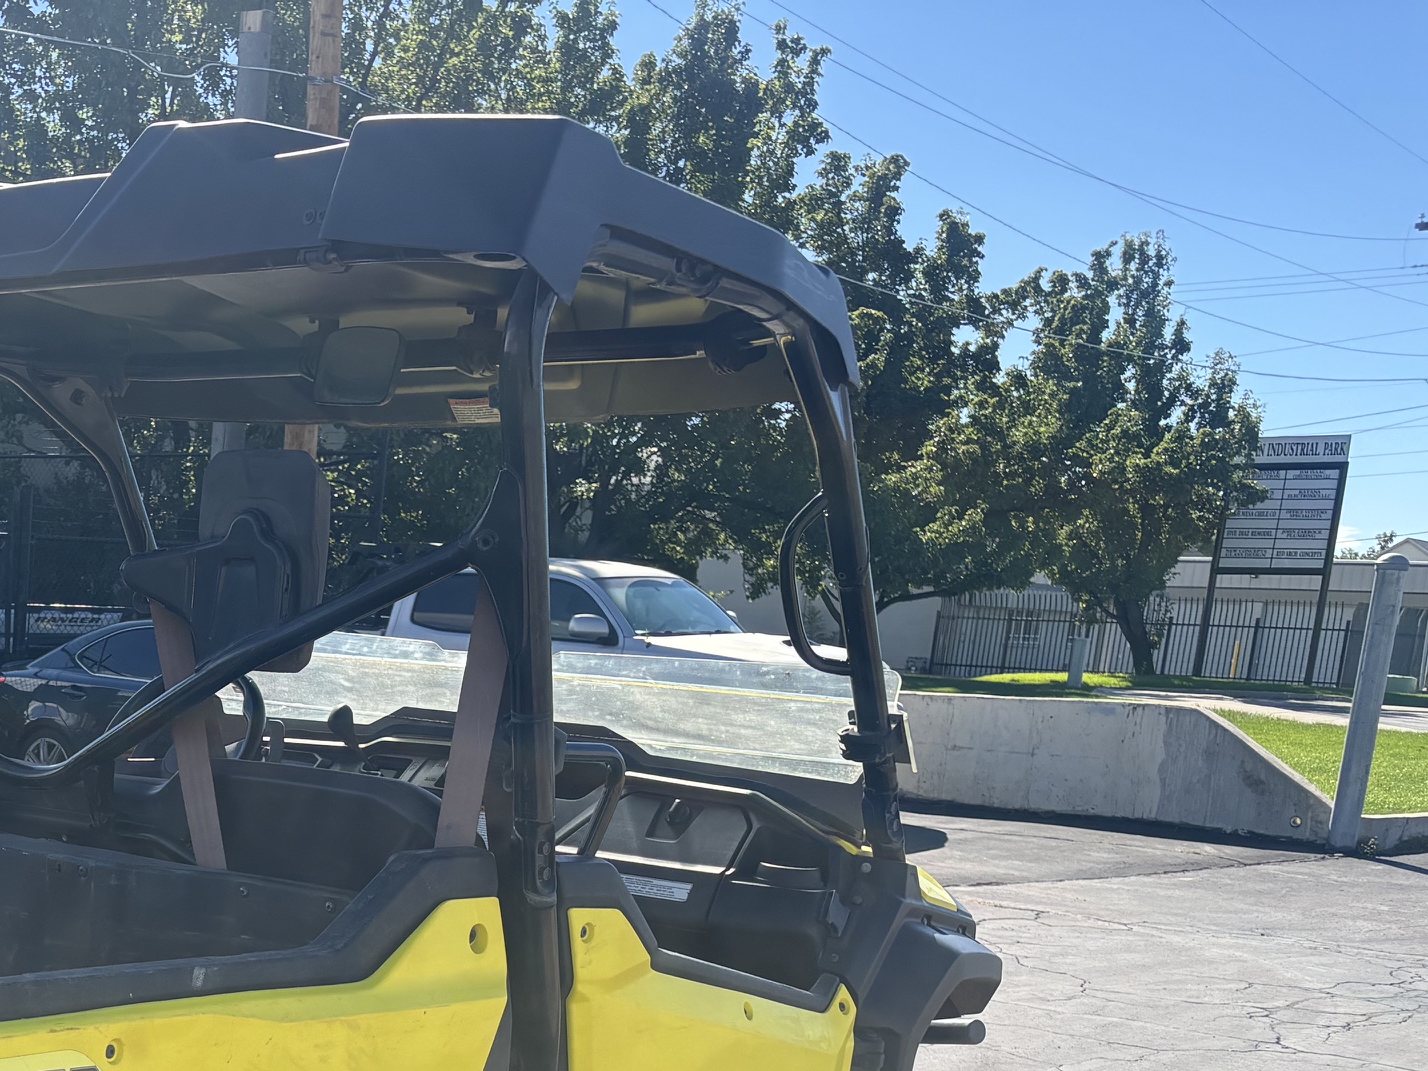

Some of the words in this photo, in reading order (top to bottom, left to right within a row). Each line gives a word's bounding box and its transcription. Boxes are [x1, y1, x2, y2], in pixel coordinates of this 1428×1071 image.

[1267, 442, 1320, 457] INDUSTRIAL
[1323, 442, 1347, 456] PARK
[1299, 550, 1322, 558] CONCEPTS
[35, 616, 102, 624] RANGER
